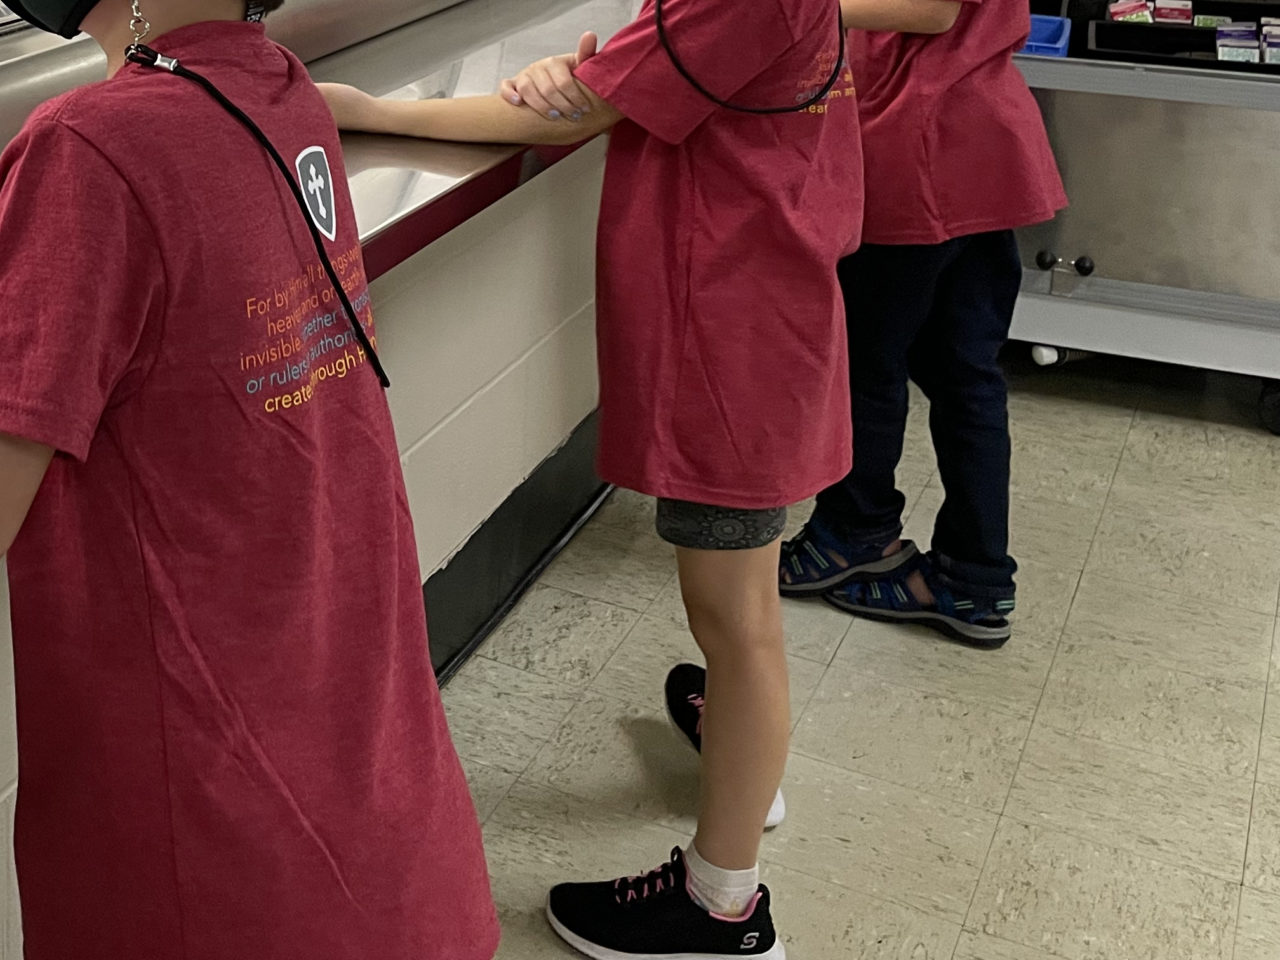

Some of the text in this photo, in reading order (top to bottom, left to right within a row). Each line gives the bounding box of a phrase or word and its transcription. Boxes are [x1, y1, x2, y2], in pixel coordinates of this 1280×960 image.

[246, 296, 272, 319] For
[274, 287, 290, 310] by
[302, 264, 315, 287] all
[317, 253, 348, 280] thngs
[240, 334, 302, 371] invisible
[303, 310, 337, 342] ether
[246, 376, 265, 394] or
[265, 384, 314, 412] create
[309, 349, 356, 385] rough
